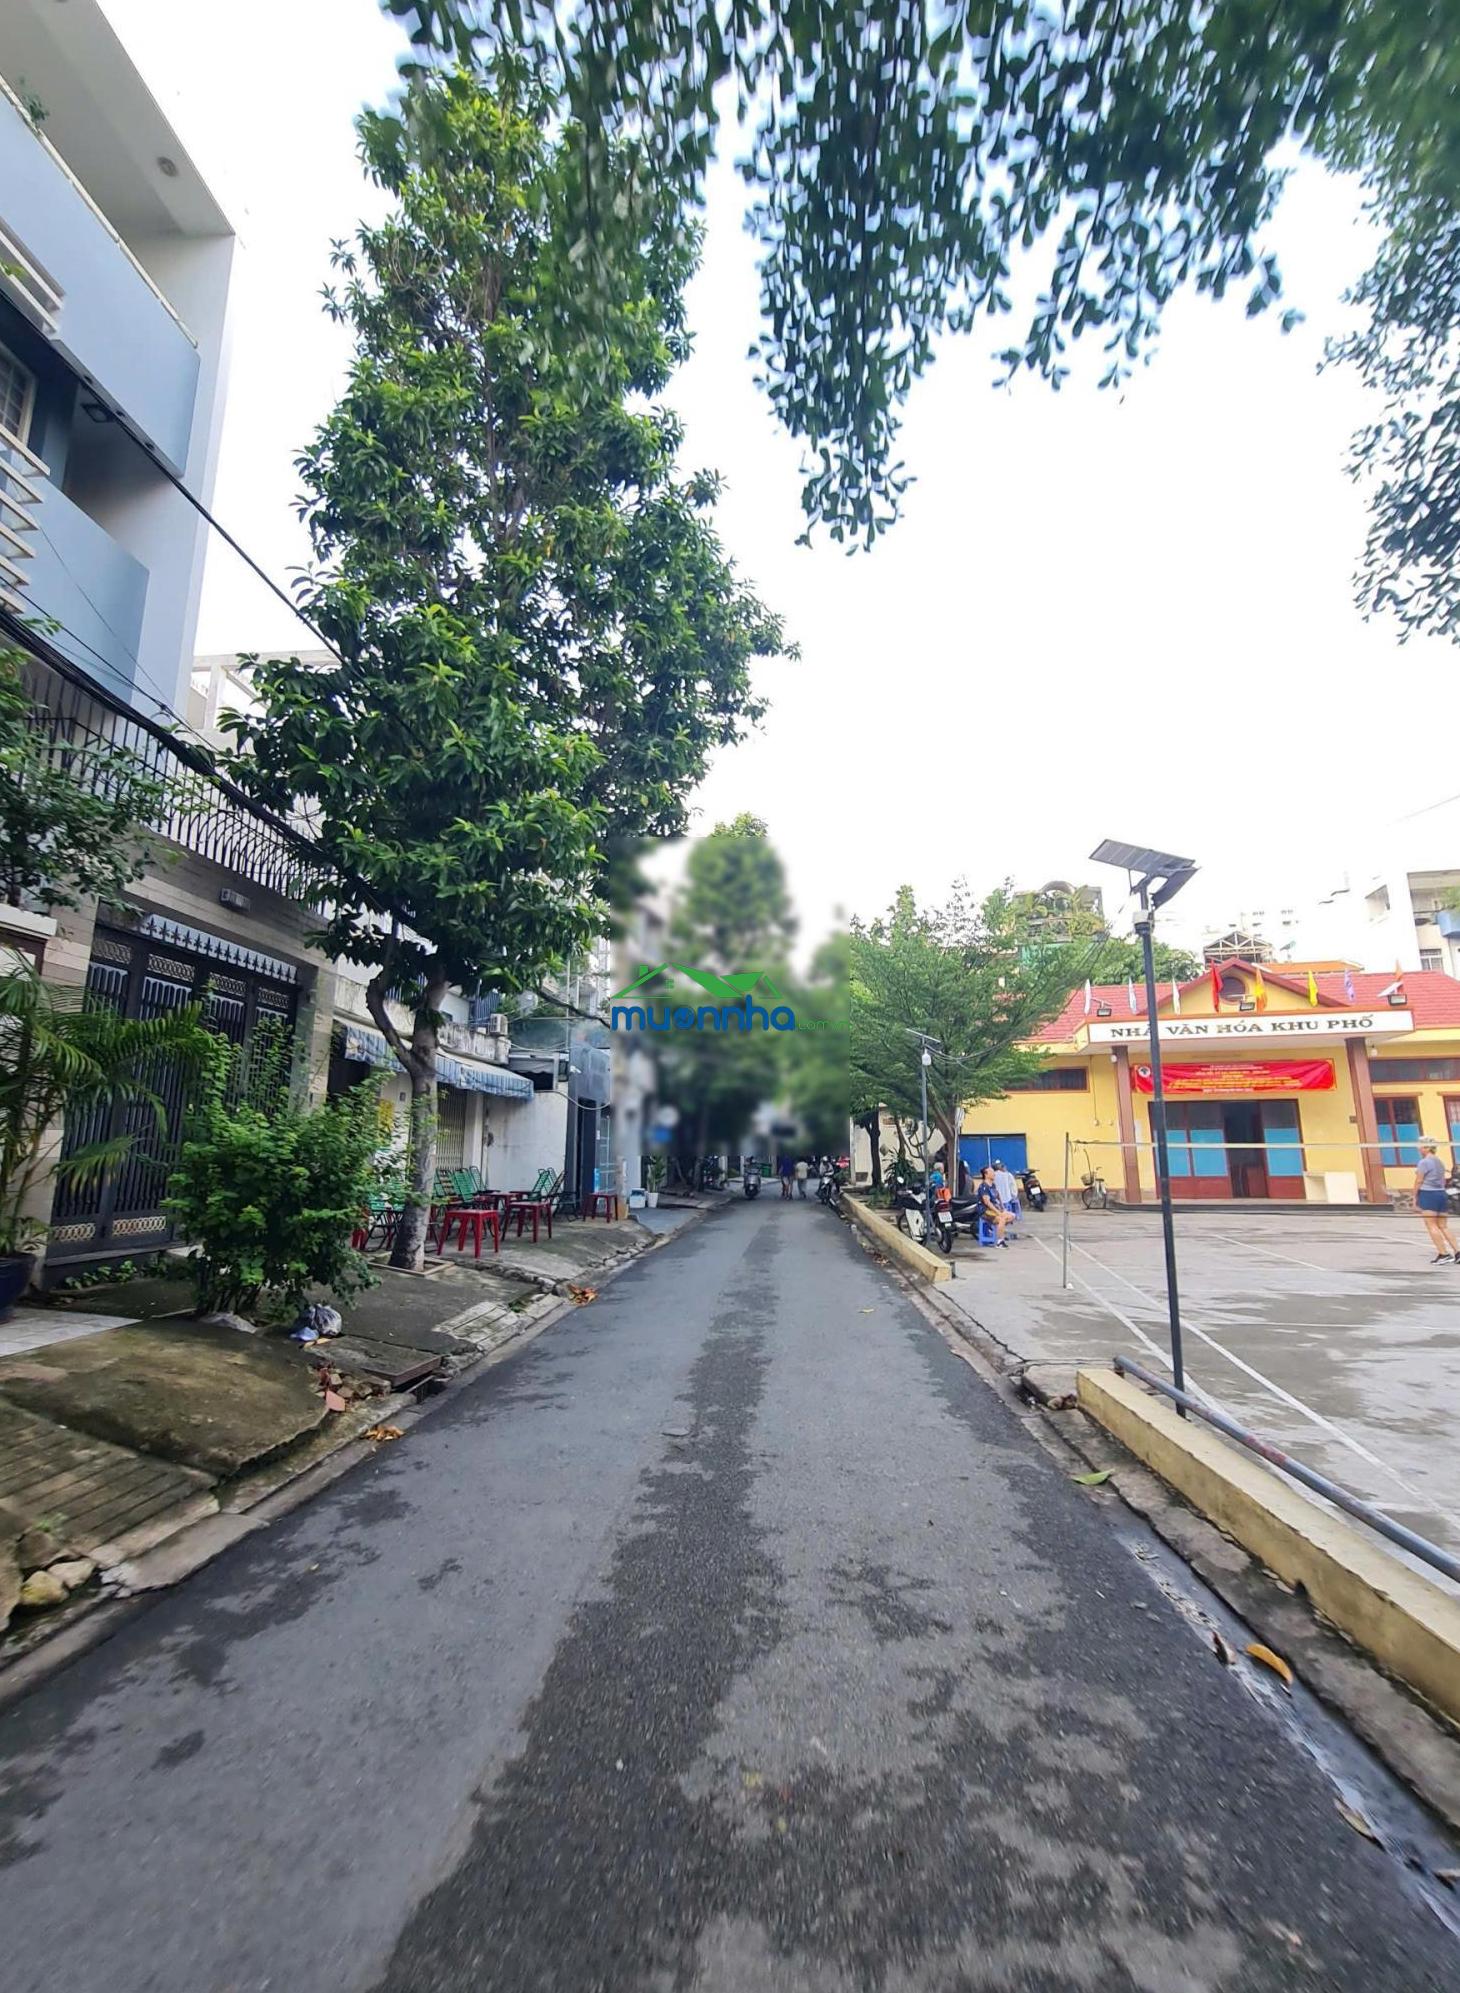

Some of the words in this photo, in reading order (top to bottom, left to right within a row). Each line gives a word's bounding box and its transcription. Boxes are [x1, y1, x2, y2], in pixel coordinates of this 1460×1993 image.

[1166, 1023, 1208, 1035] VĂN
[1217, 1019, 1263, 1033] HÓA
[1271, 1020, 1319, 1032] KHU
[1326, 1014, 1374, 1029] PHỐ
